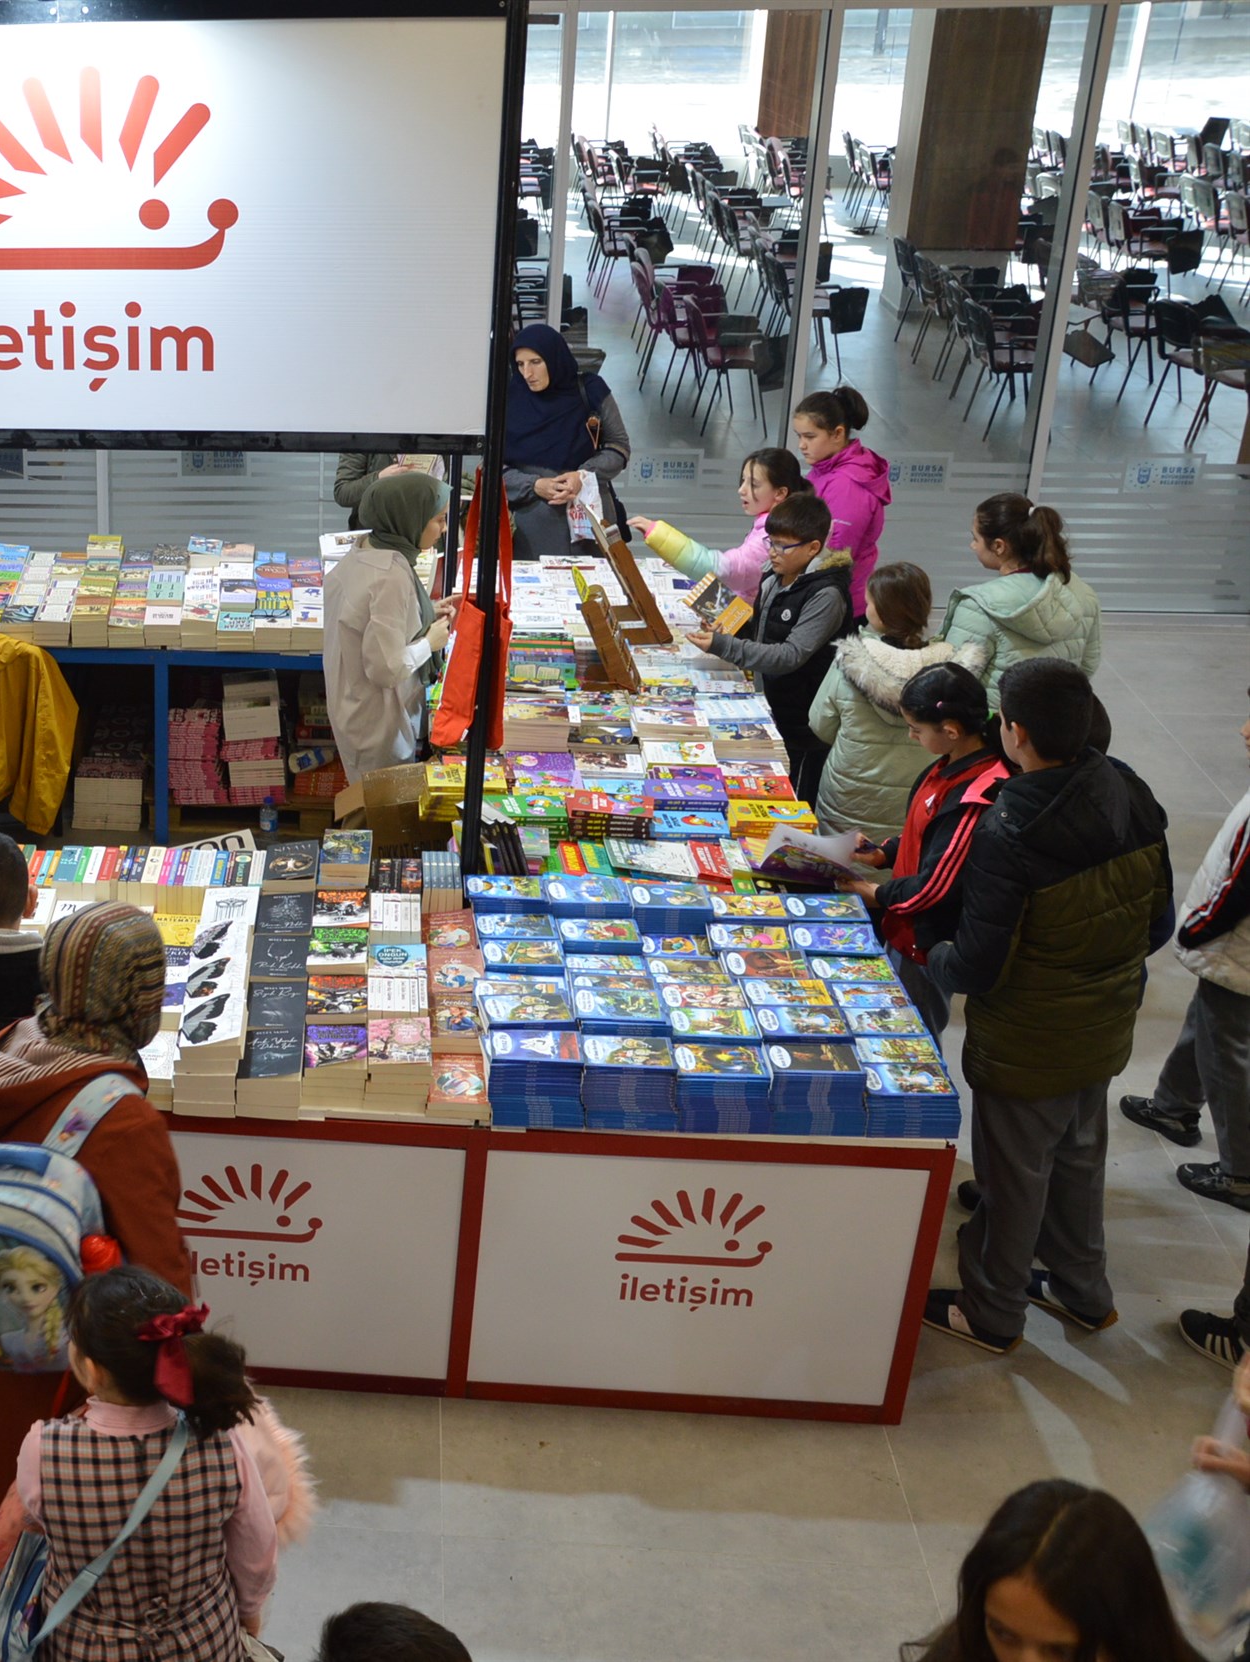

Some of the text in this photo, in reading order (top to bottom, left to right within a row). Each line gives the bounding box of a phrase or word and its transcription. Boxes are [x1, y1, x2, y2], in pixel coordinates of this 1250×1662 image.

[1162, 466, 1195, 474] BURSA
[191, 1250, 310, 1287] letişim
[619, 1273, 753, 1312] iletişim
